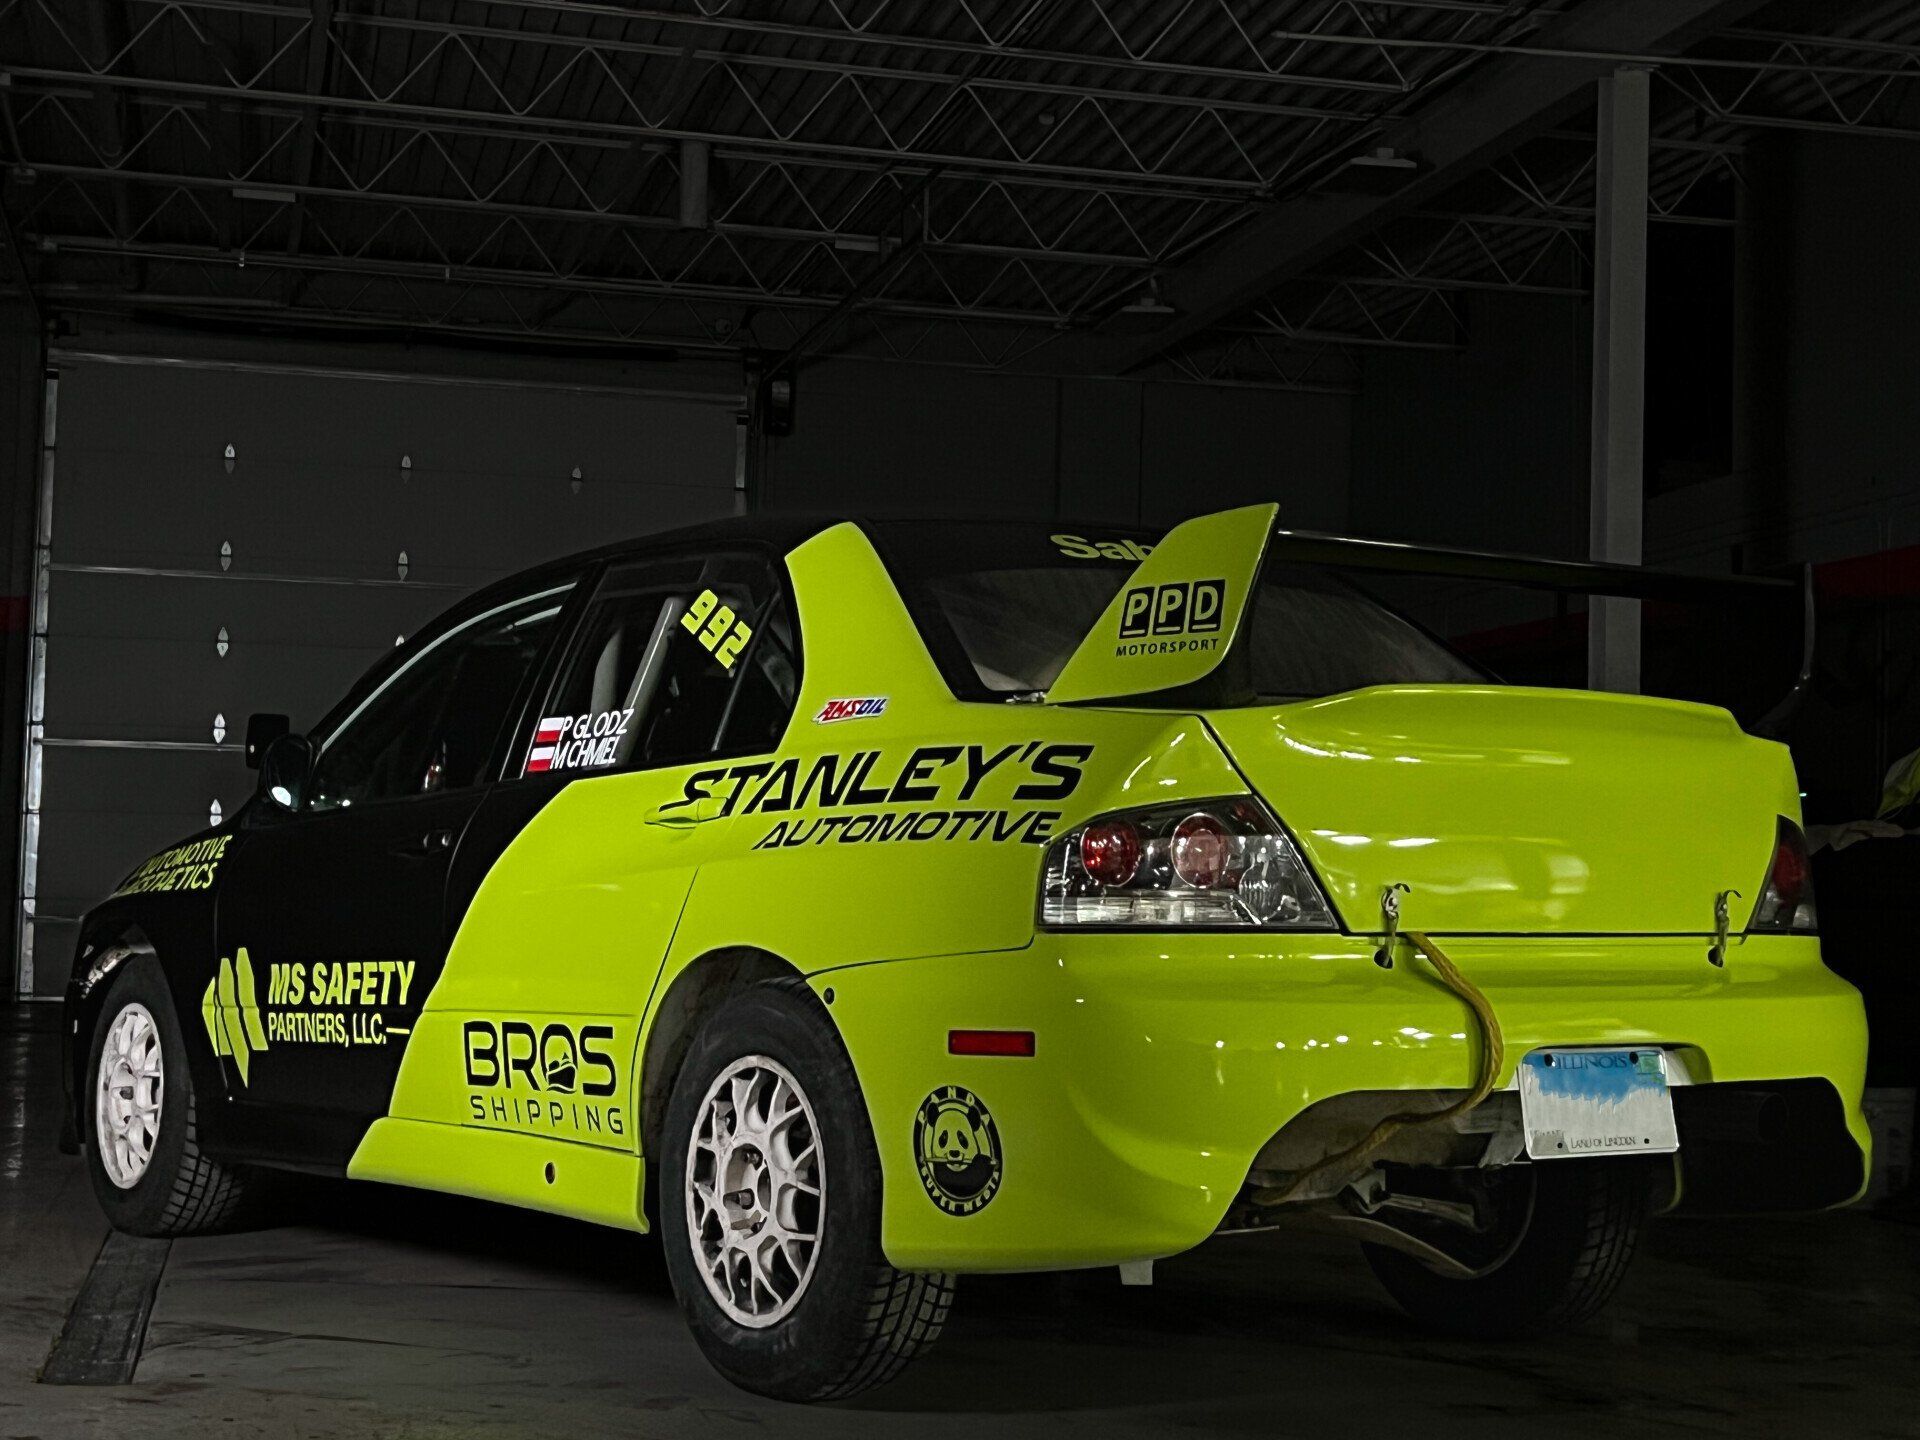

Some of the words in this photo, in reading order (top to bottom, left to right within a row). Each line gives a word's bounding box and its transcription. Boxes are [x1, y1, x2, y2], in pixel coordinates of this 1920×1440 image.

[1119, 579, 1226, 639] PPD
[681, 589, 753, 669] 992
[1116, 638, 1219, 657] MOTORSPORT
[558, 716, 574, 741] P
[573, 709, 634, 739] GLODZ
[816, 698, 887, 720] AMSOIL
[549, 741, 568, 770] M
[566, 735, 621, 767] CHMIEL
[659, 741, 1095, 818] STANLEY'S
[752, 811, 1063, 850] AUTOMOTIVE
[268, 963, 306, 1005] MS
[310, 961, 416, 1006] SAFETY
[269, 1012, 350, 1048] PARTNERS,
[463, 1020, 617, 1097] BROS
[1556, 1054, 1627, 1069] ILLINOIS
[470, 1095, 624, 1135] SHIPPING
[917, 1085, 991, 1126] PANDA
